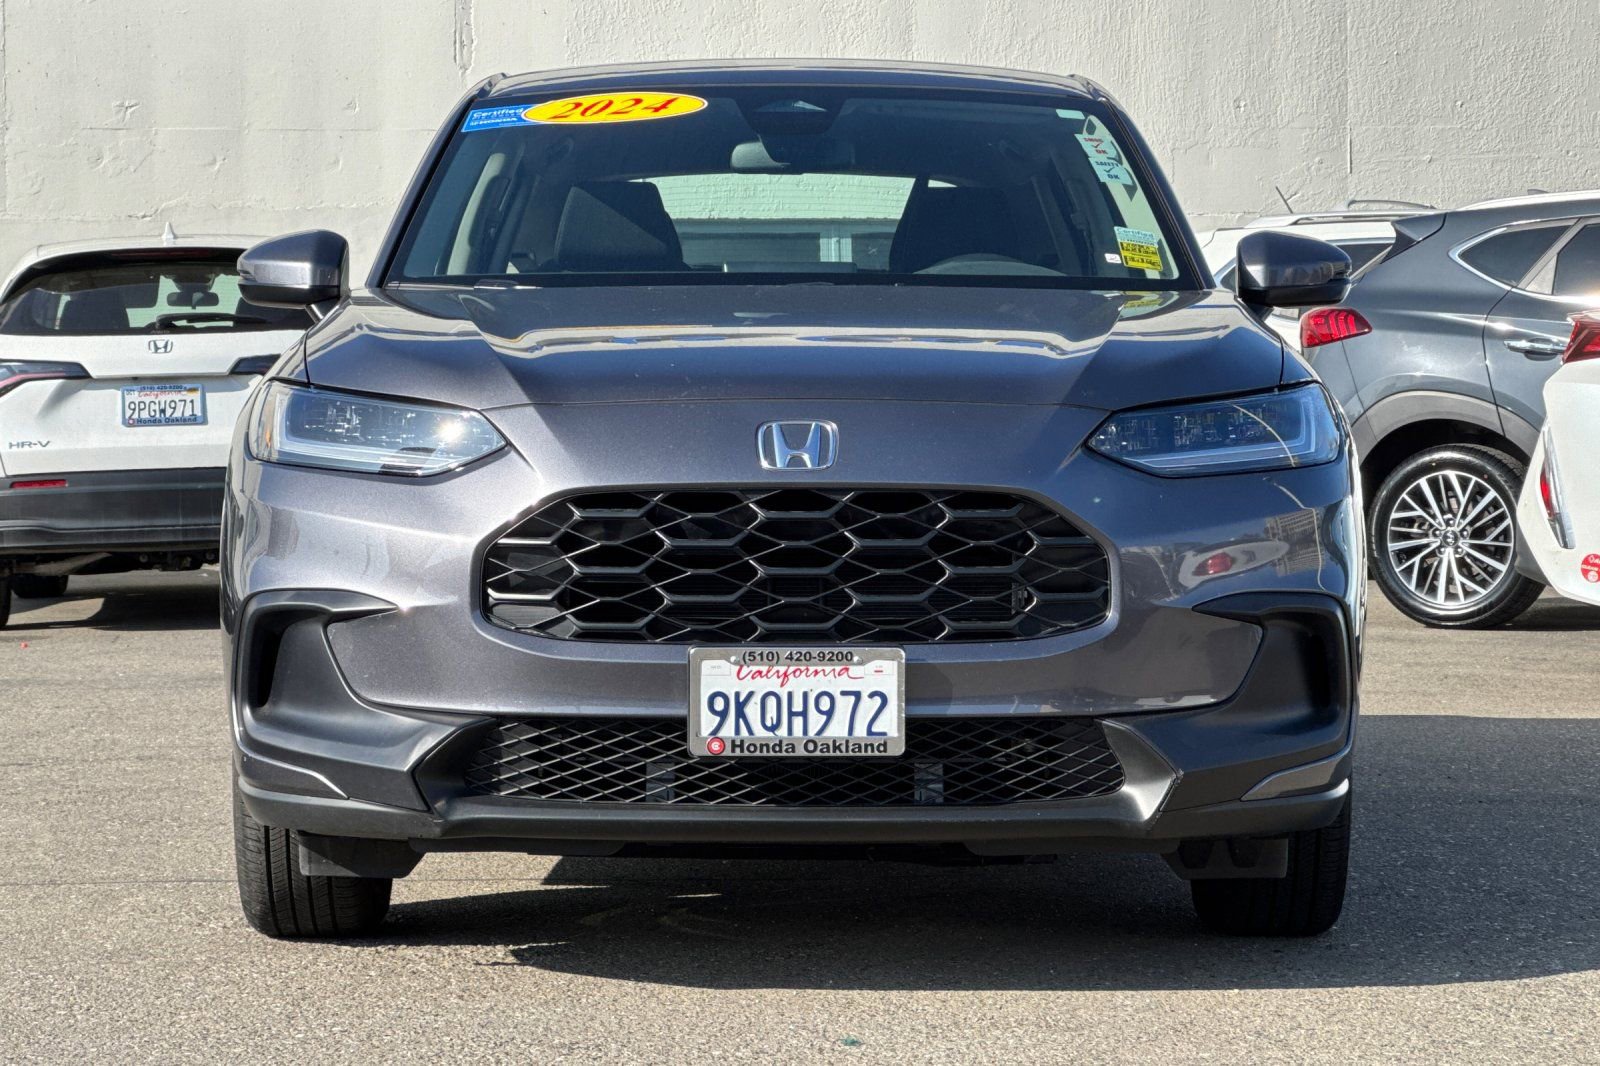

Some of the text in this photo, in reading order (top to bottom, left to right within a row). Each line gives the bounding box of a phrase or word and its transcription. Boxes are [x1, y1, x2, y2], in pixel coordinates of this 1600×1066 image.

[473, 107, 523, 118] Certified
[549, 97, 680, 120] 2024
[128, 399, 197, 419] 9PGW971
[9, 441, 51, 449] HR-V
[742, 651, 853, 664] (510) 420-9200
[736, 665, 864, 688] California
[707, 690, 888, 737] 9KQH972
[730, 739, 796, 754] Honda
[803, 739, 888, 754] Oakland
